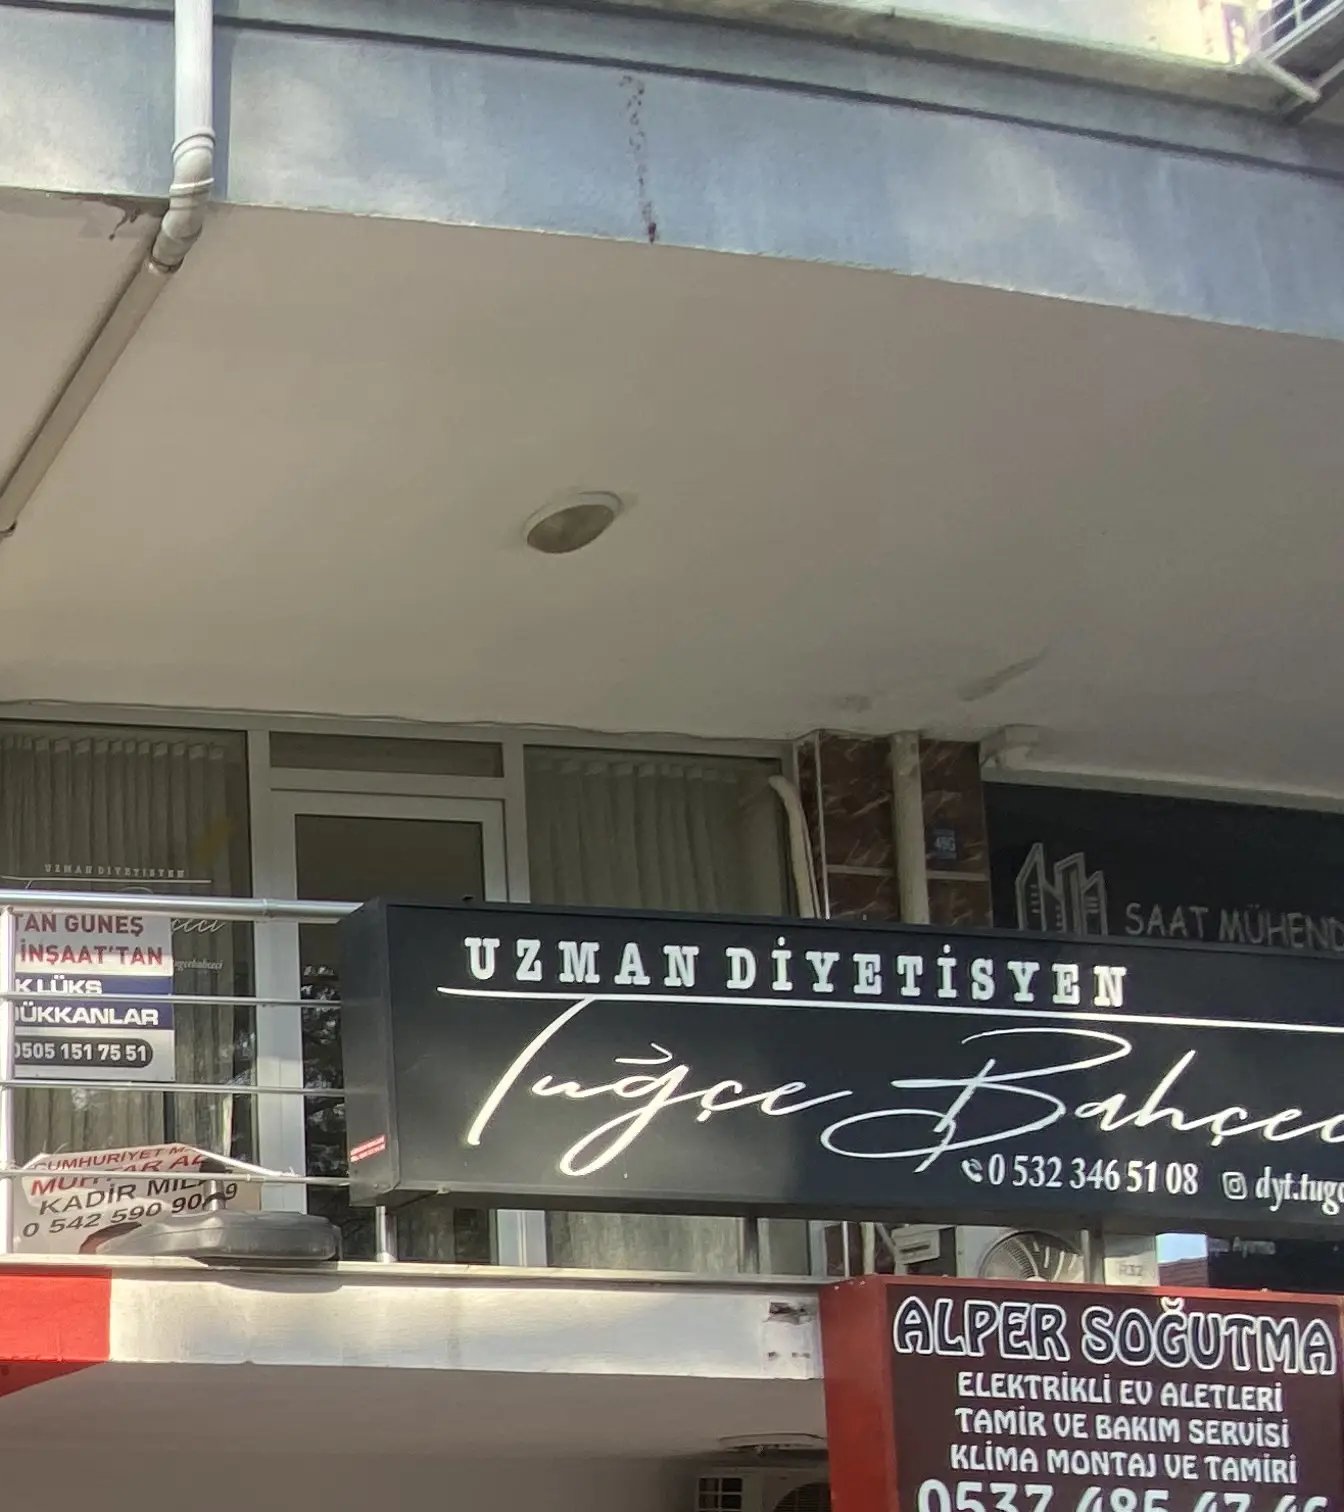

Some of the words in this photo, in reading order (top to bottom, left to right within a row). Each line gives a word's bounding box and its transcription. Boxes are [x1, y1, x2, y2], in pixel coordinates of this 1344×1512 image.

[1125, 902, 1210, 938] SAAT
[37, 974, 103, 996] LÜKS
[465, 936, 700, 988] UZMAN
[726, 934, 1128, 1009] DİYETİSYEN
[60, 1042, 94, 1061] 151
[98, 1044, 121, 1062] 75
[125, 1044, 147, 1063] 51
[467, 998, 853, 1178] Tuğçe
[988, 1154, 1005, 1185] 0
[1012, 1156, 1062, 1189] 532
[1070, 1158, 1120, 1191] 346
[1127, 1160, 1158, 1193] 51
[1166, 1162, 1200, 1196] 08
[39, 1183, 136, 1215] KADİR
[22, 1222, 40, 1238] 0
[48, 1213, 101, 1235] 542
[111, 1203, 162, 1224] 590
[893, 1296, 1069, 1363] ALPER
[1081, 1297, 1336, 1376] SOĞUTMA
[958, 1370, 1112, 1405] ELEKTRİKLİ
[1120, 1380, 1153, 1406] EV
[1160, 1379, 1284, 1413] ALETLERİ
[955, 1405, 1047, 1437] TAMİR
[1053, 1412, 1087, 1438] VE
[1095, 1413, 1181, 1444] BAKIM
[1188, 1416, 1290, 1449] SERVİSİ
[950, 1444, 1038, 1474] KLİMA
[1047, 1447, 1156, 1478] MONTAJ
[1164, 1453, 1199, 1480] VE
[1205, 1451, 1298, 1485] TAMİRİ
